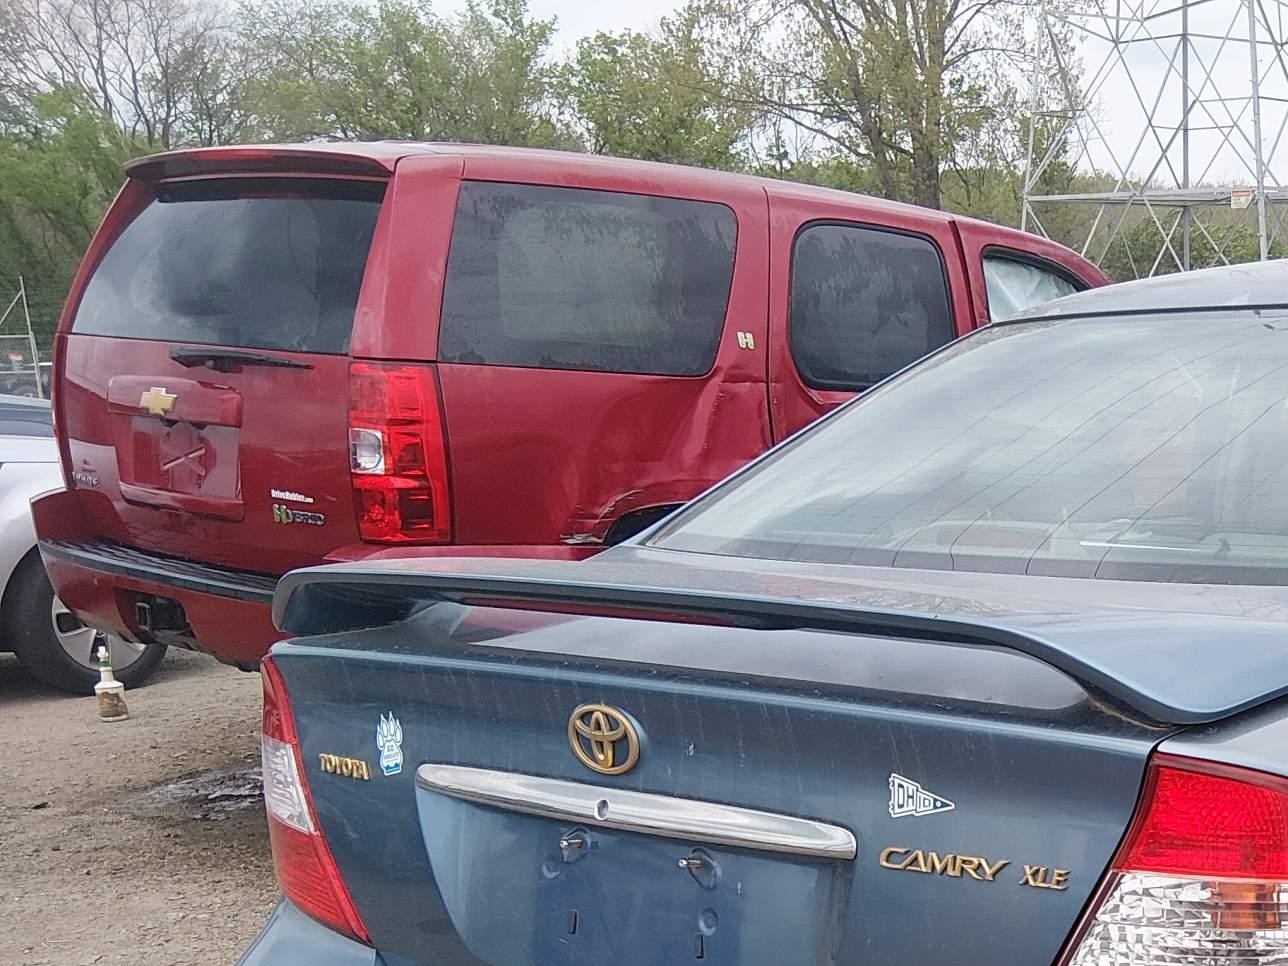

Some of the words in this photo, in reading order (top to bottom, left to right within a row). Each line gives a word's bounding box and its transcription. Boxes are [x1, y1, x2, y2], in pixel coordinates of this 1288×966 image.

[319, 753, 370, 780] TOYOTA
[880, 847, 1012, 881] CAMRY
[1018, 864, 1072, 890] XLE
